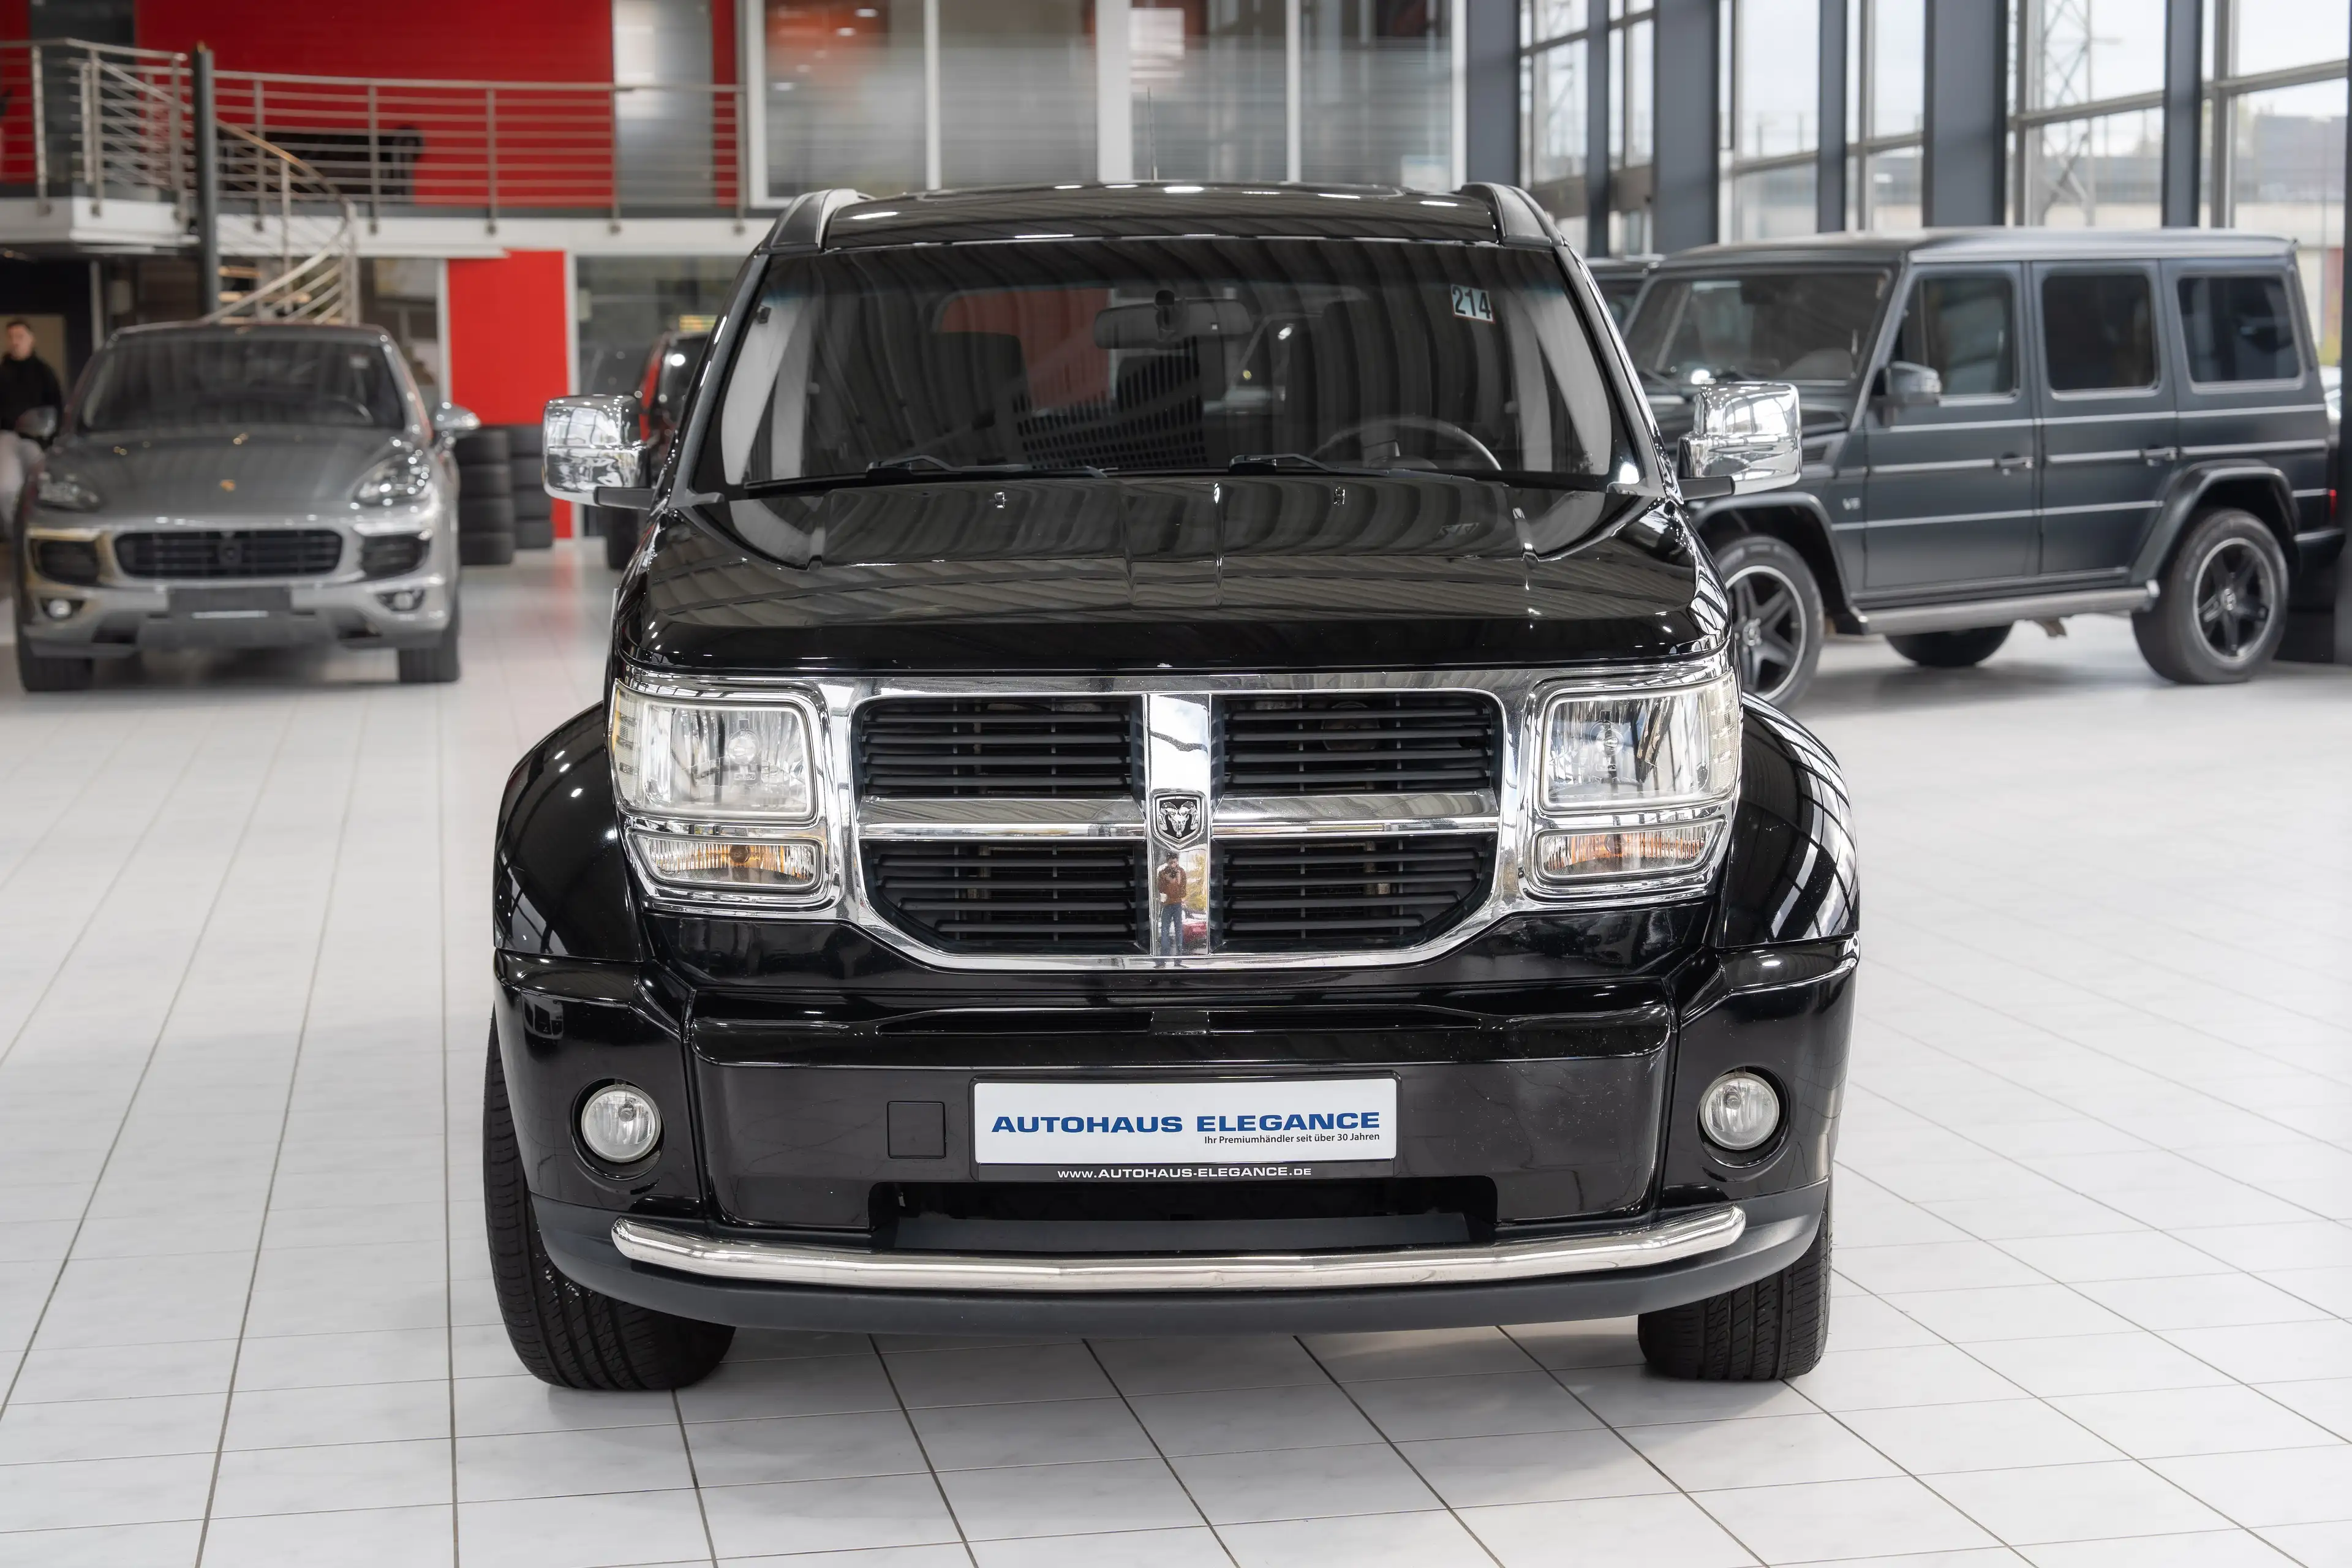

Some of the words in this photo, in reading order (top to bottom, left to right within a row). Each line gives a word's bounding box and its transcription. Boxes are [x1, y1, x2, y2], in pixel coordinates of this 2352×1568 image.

[1452, 285, 1491, 319] 214
[991, 1116, 1183, 1133] AUTOHAUS
[1197, 1112, 1380, 1132] ELEGANCE
[1204, 1136, 1217, 1144] Ihr
[1219, 1134, 1294, 1144] Premiumhändler
[1296, 1134, 1313, 1142] seit
[1314, 1133, 1335, 1142] über
[1337, 1133, 1348, 1142] 30
[1349, 1132, 1380, 1141] Jahren
